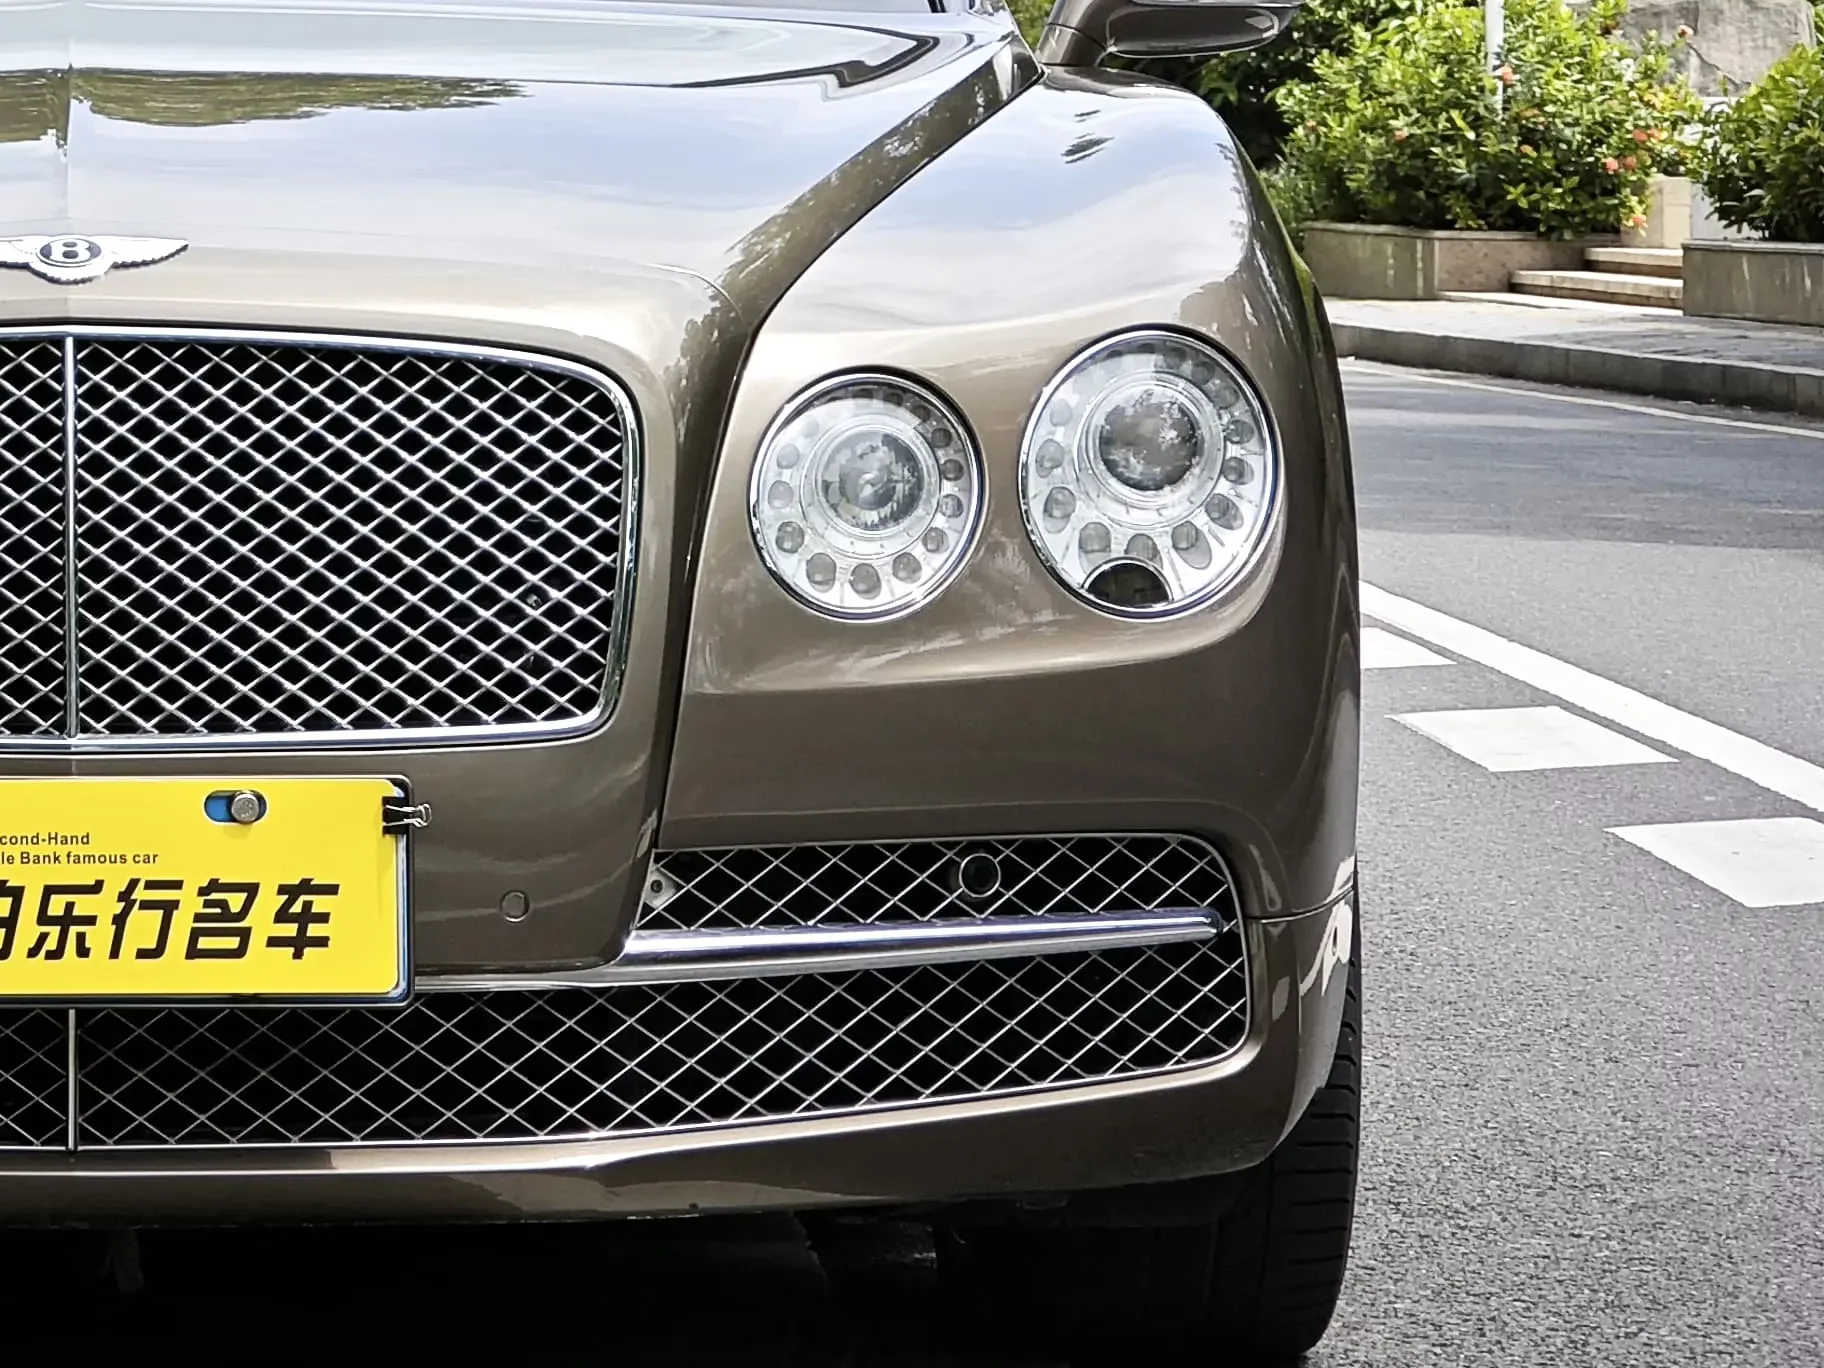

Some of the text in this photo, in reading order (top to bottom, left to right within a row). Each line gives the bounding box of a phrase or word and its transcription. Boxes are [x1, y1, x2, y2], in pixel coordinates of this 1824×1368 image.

[50, 238, 92, 263] B
[19, 851, 62, 865] Bank
[66, 851, 128, 865] famous
[132, 853, 159, 865] car
